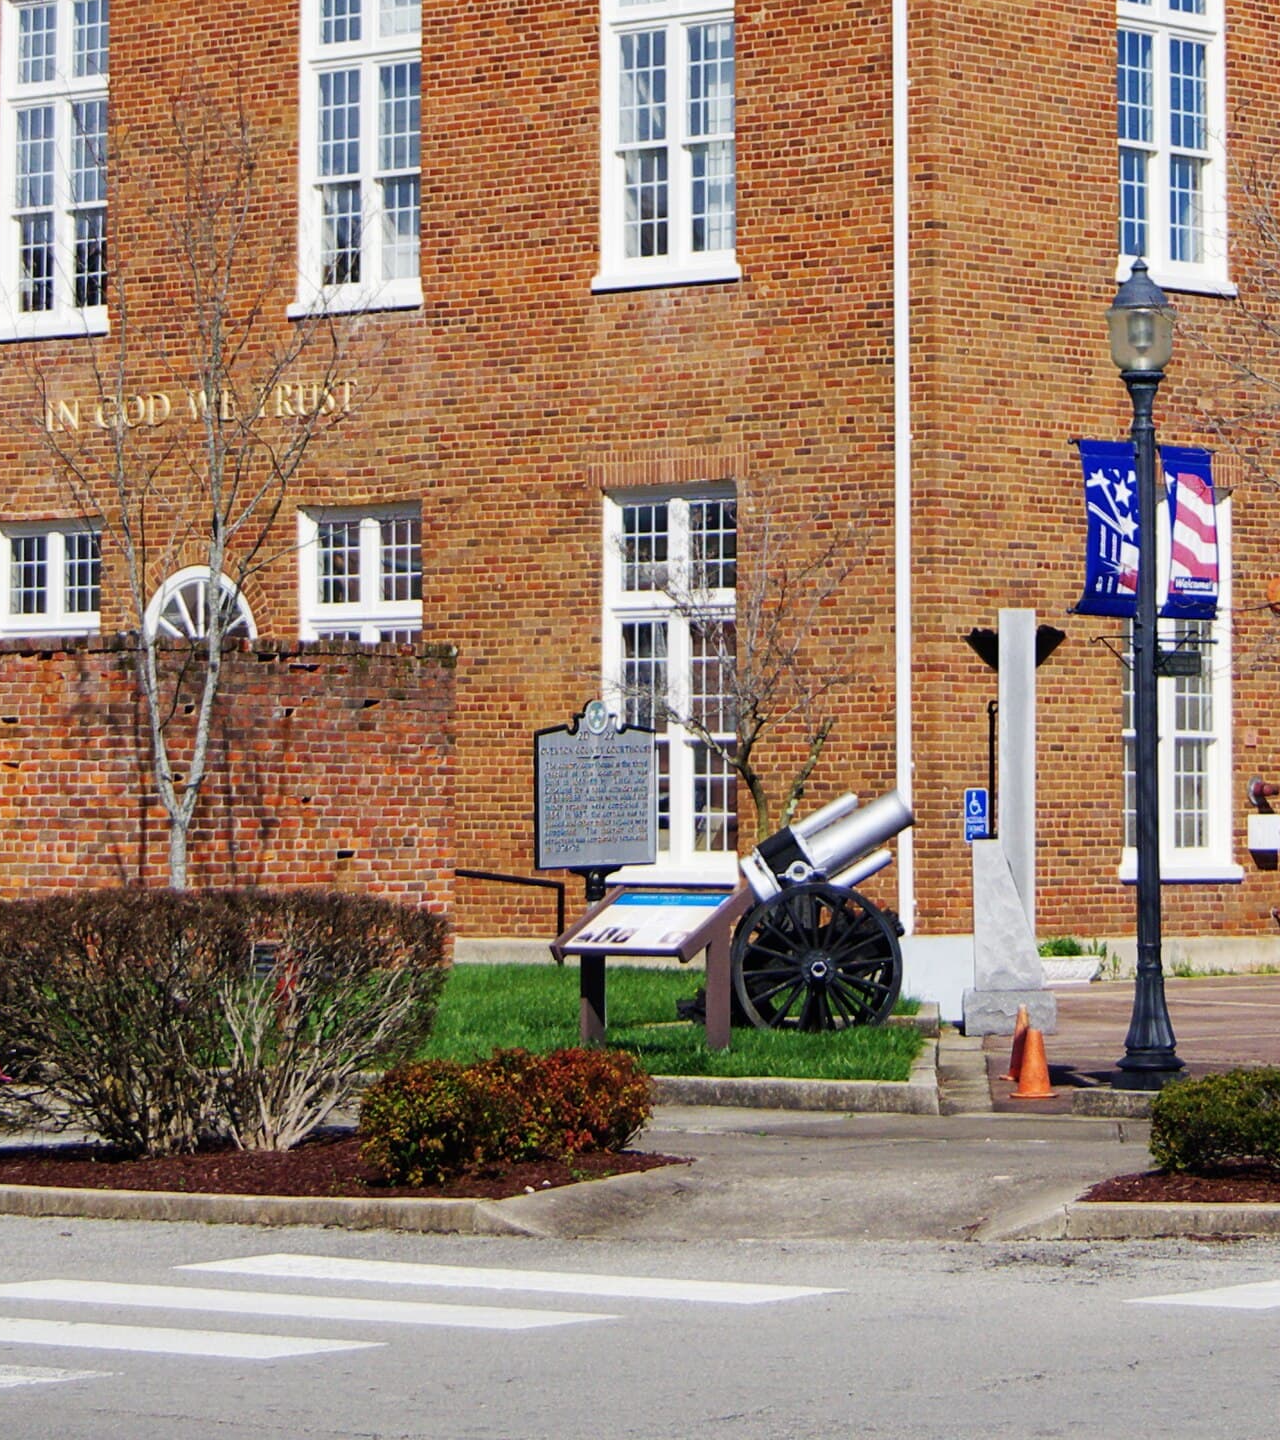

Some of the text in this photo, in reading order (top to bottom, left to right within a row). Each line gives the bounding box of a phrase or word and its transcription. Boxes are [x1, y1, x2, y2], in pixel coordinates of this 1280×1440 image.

[46, 398, 81, 432] IN
[95, 393, 170, 430] GOD
[254, 378, 358, 418] TRUST
